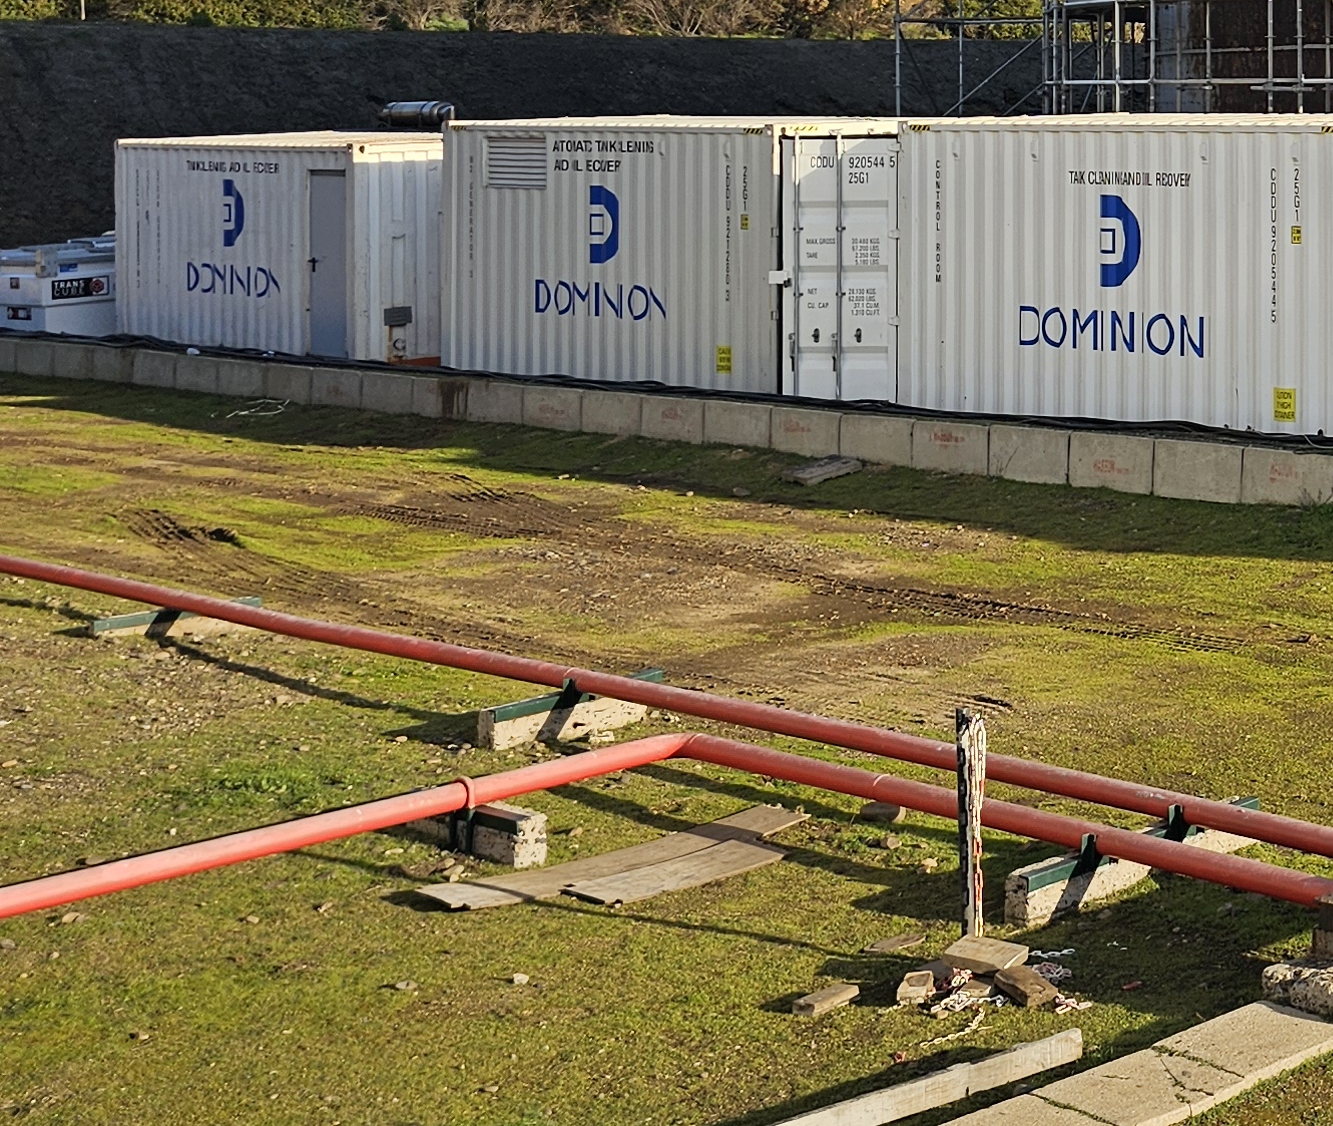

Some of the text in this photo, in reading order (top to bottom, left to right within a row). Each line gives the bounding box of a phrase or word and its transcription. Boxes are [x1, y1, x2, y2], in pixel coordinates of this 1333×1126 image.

[810, 156, 896, 169] CDDU 920544 5
[848, 172, 869, 184] 25G1
[54, 280, 85, 289] TRANS
[54, 287, 85, 296] CUBE
[1019, 305, 1205, 358] DOMINION
